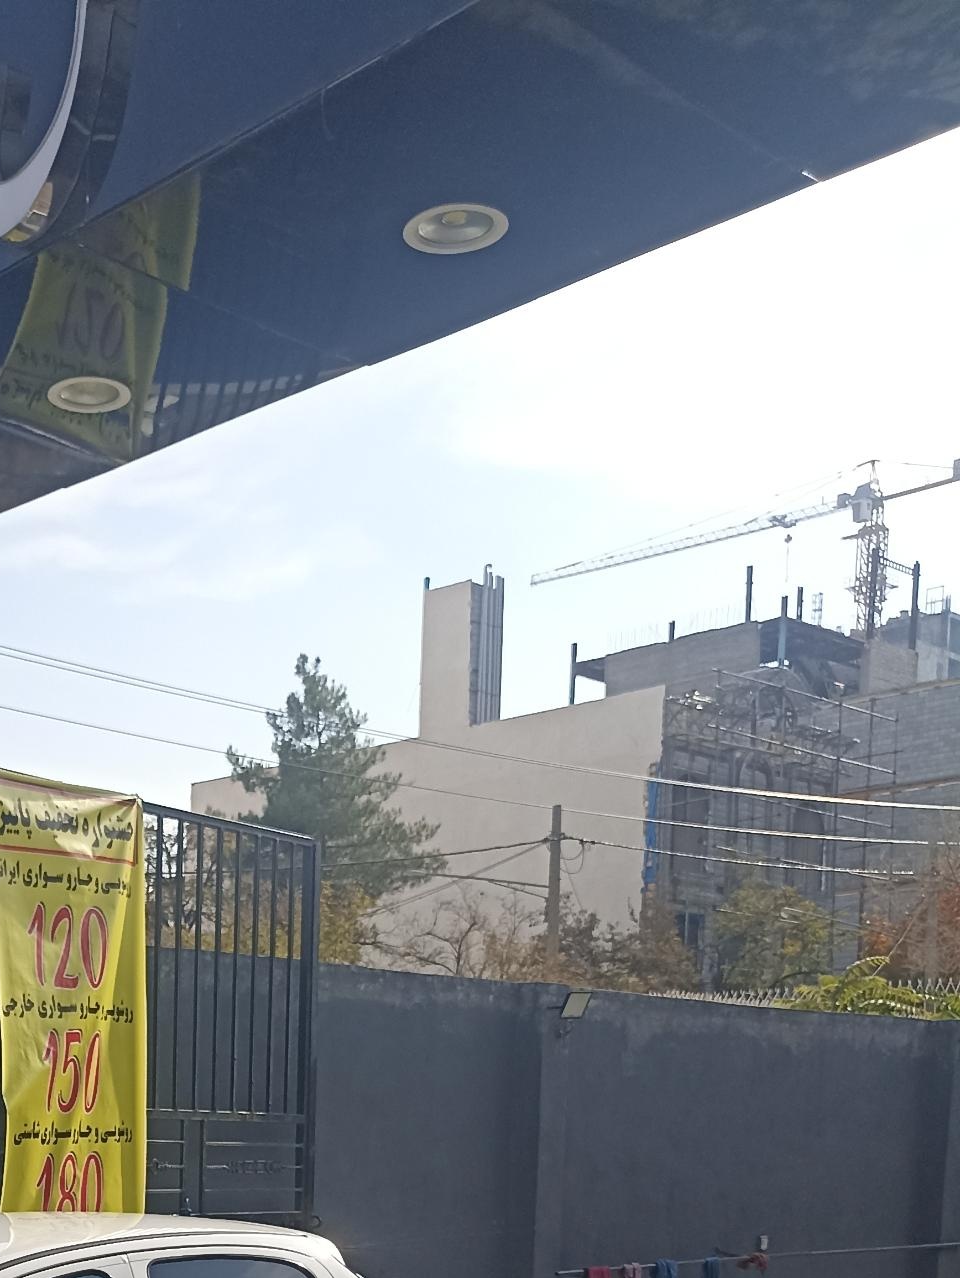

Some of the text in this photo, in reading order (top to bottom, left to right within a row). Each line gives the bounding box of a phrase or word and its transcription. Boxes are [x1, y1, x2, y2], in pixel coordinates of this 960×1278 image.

[34, 803, 79, 839] تخفیف
[23, 862, 64, 889] سواری
[26, 901, 109, 990] 120
[2, 993, 35, 1018] خارجی
[37, 995, 77, 1019] سواری
[42, 1028, 101, 1115] 150
[36, 1151, 104, 1214] 180
